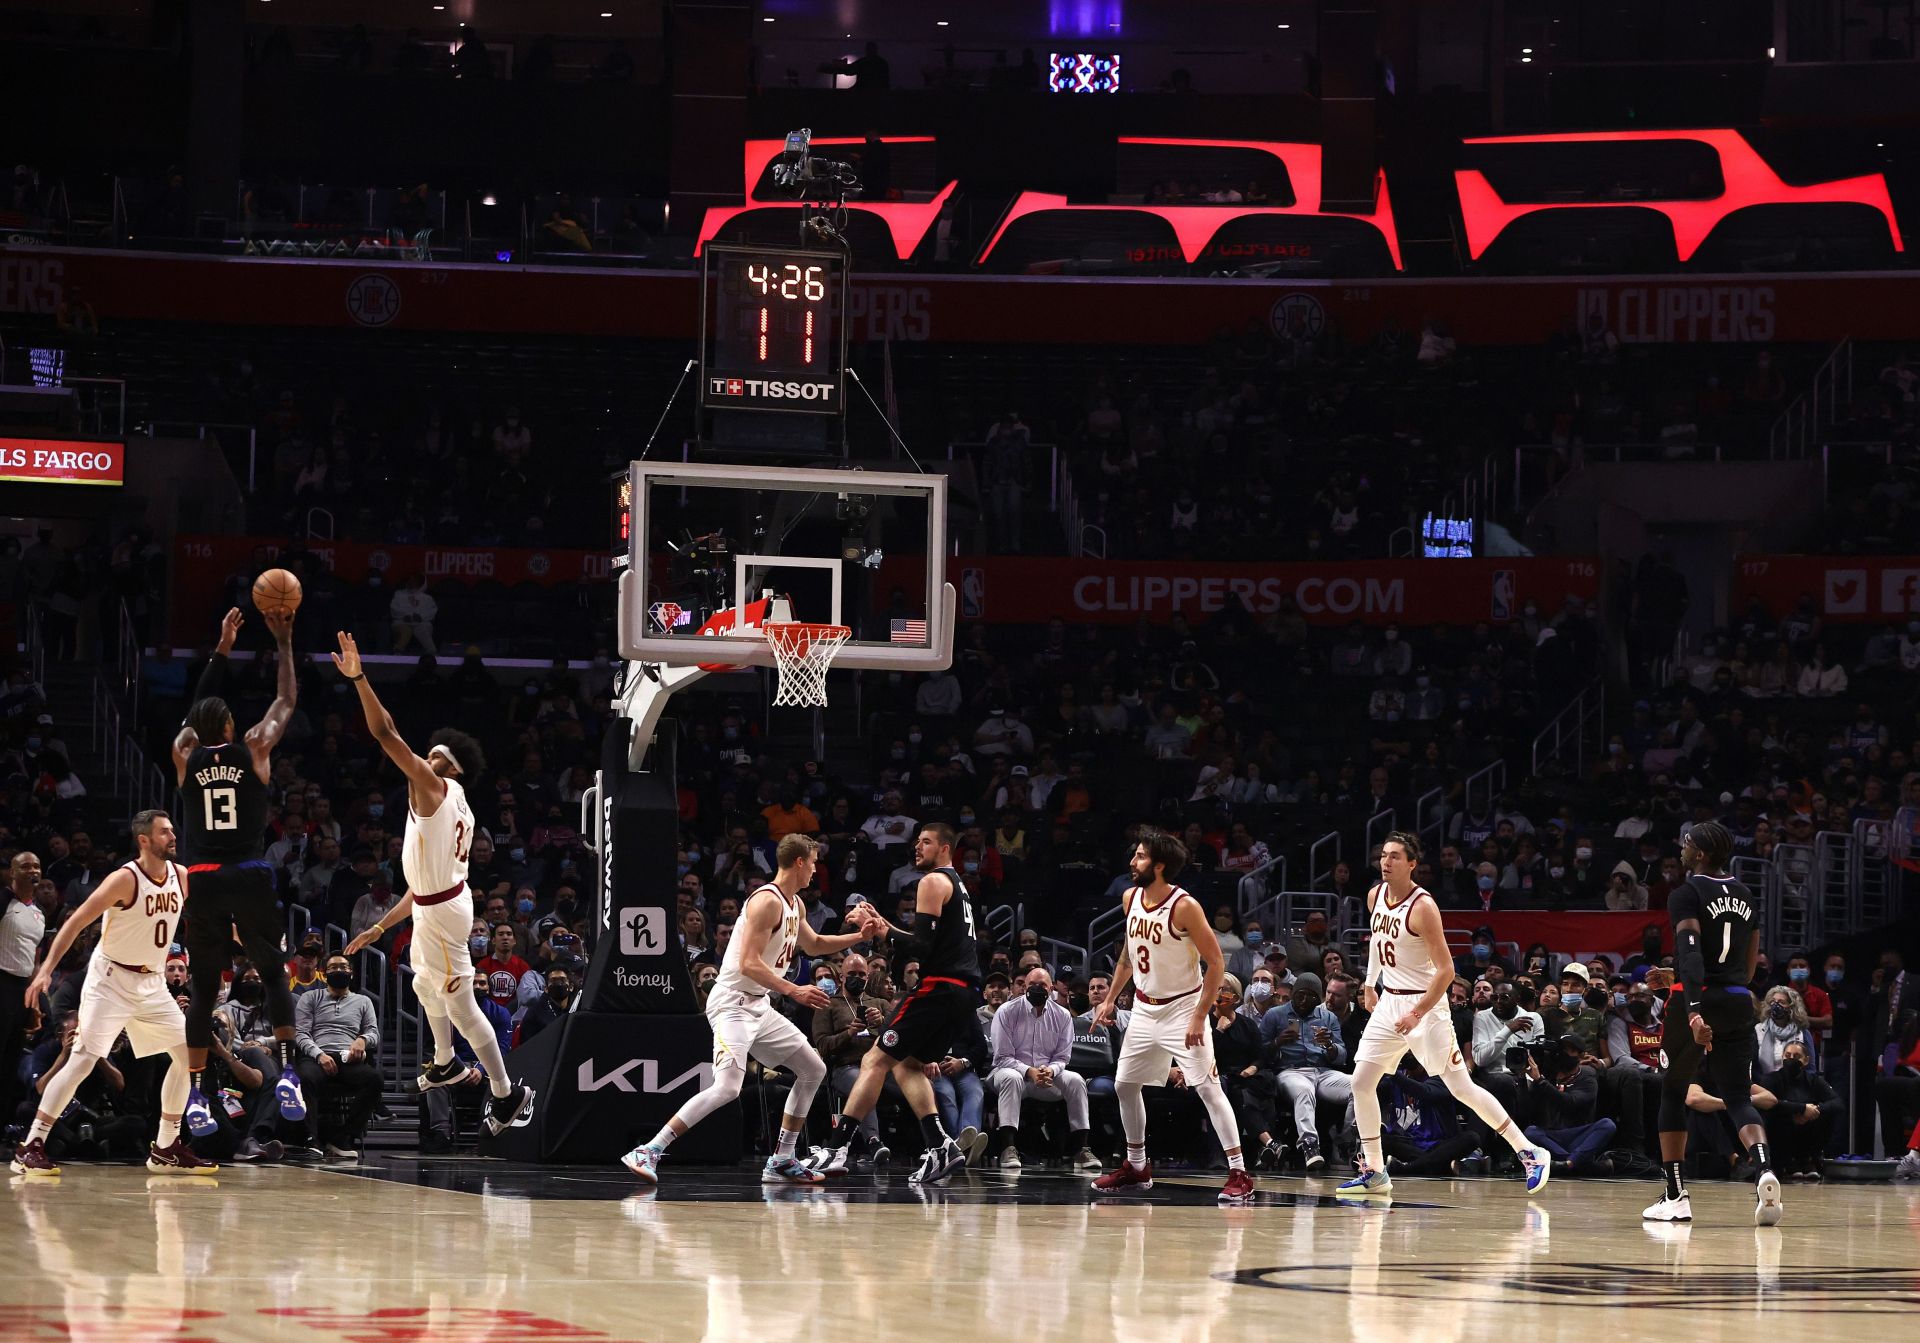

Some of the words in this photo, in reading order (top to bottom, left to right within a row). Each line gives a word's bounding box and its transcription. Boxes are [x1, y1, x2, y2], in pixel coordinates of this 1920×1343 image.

[748, 265, 825, 301] 4:26
[1618, 286, 1775, 343] CLIPPERS
[759, 307, 812, 363] 11
[745, 380, 835, 401] TISSOT
[33, 450, 112, 471] FARGO
[184, 543, 212, 557] 116
[424, 550, 496, 576] CLIPPERS
[1567, 562, 1595, 577] 116
[1743, 562, 1768, 576] 117
[1073, 575, 1405, 615] CLIPPERSCOM
[195, 765, 244, 787] GEORGE
[203, 788, 238, 831] 13
[603, 796, 613, 931] betway
[145, 891, 178, 917] CAVS
[1706, 896, 1752, 922] JACKSON
[154, 919, 168, 949] 0
[1129, 915, 1163, 945] CAVS
[1372, 912, 1401, 939] CAVS
[1377, 939, 1397, 968] 16
[1718, 921, 1732, 963] 1
[1137, 945, 1150, 974] 3
[613, 966, 675, 995] honey
